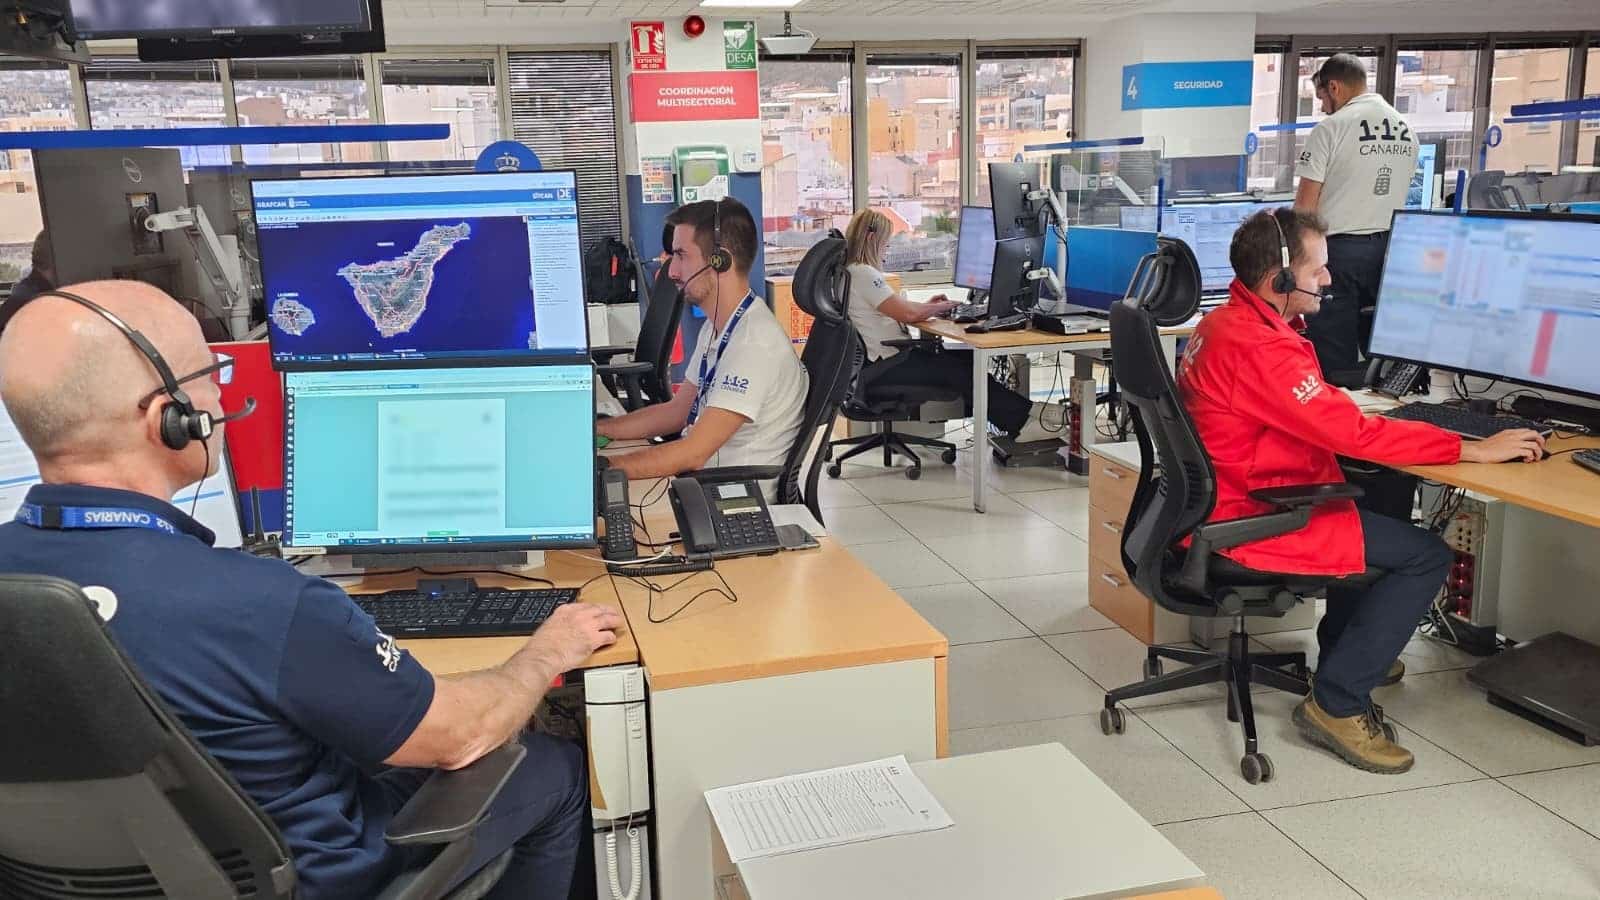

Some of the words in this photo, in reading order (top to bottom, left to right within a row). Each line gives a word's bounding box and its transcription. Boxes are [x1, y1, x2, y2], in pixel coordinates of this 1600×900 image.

[727, 52, 754, 64] DESA
[658, 85, 734, 96] COORDINACIÓN
[1127, 76, 1138, 100] 4
[1174, 80, 1224, 90] SEGURIDAD
[656, 97, 736, 107] MULTISECTORIAL
[84, 510, 151, 525] CANARIAS
